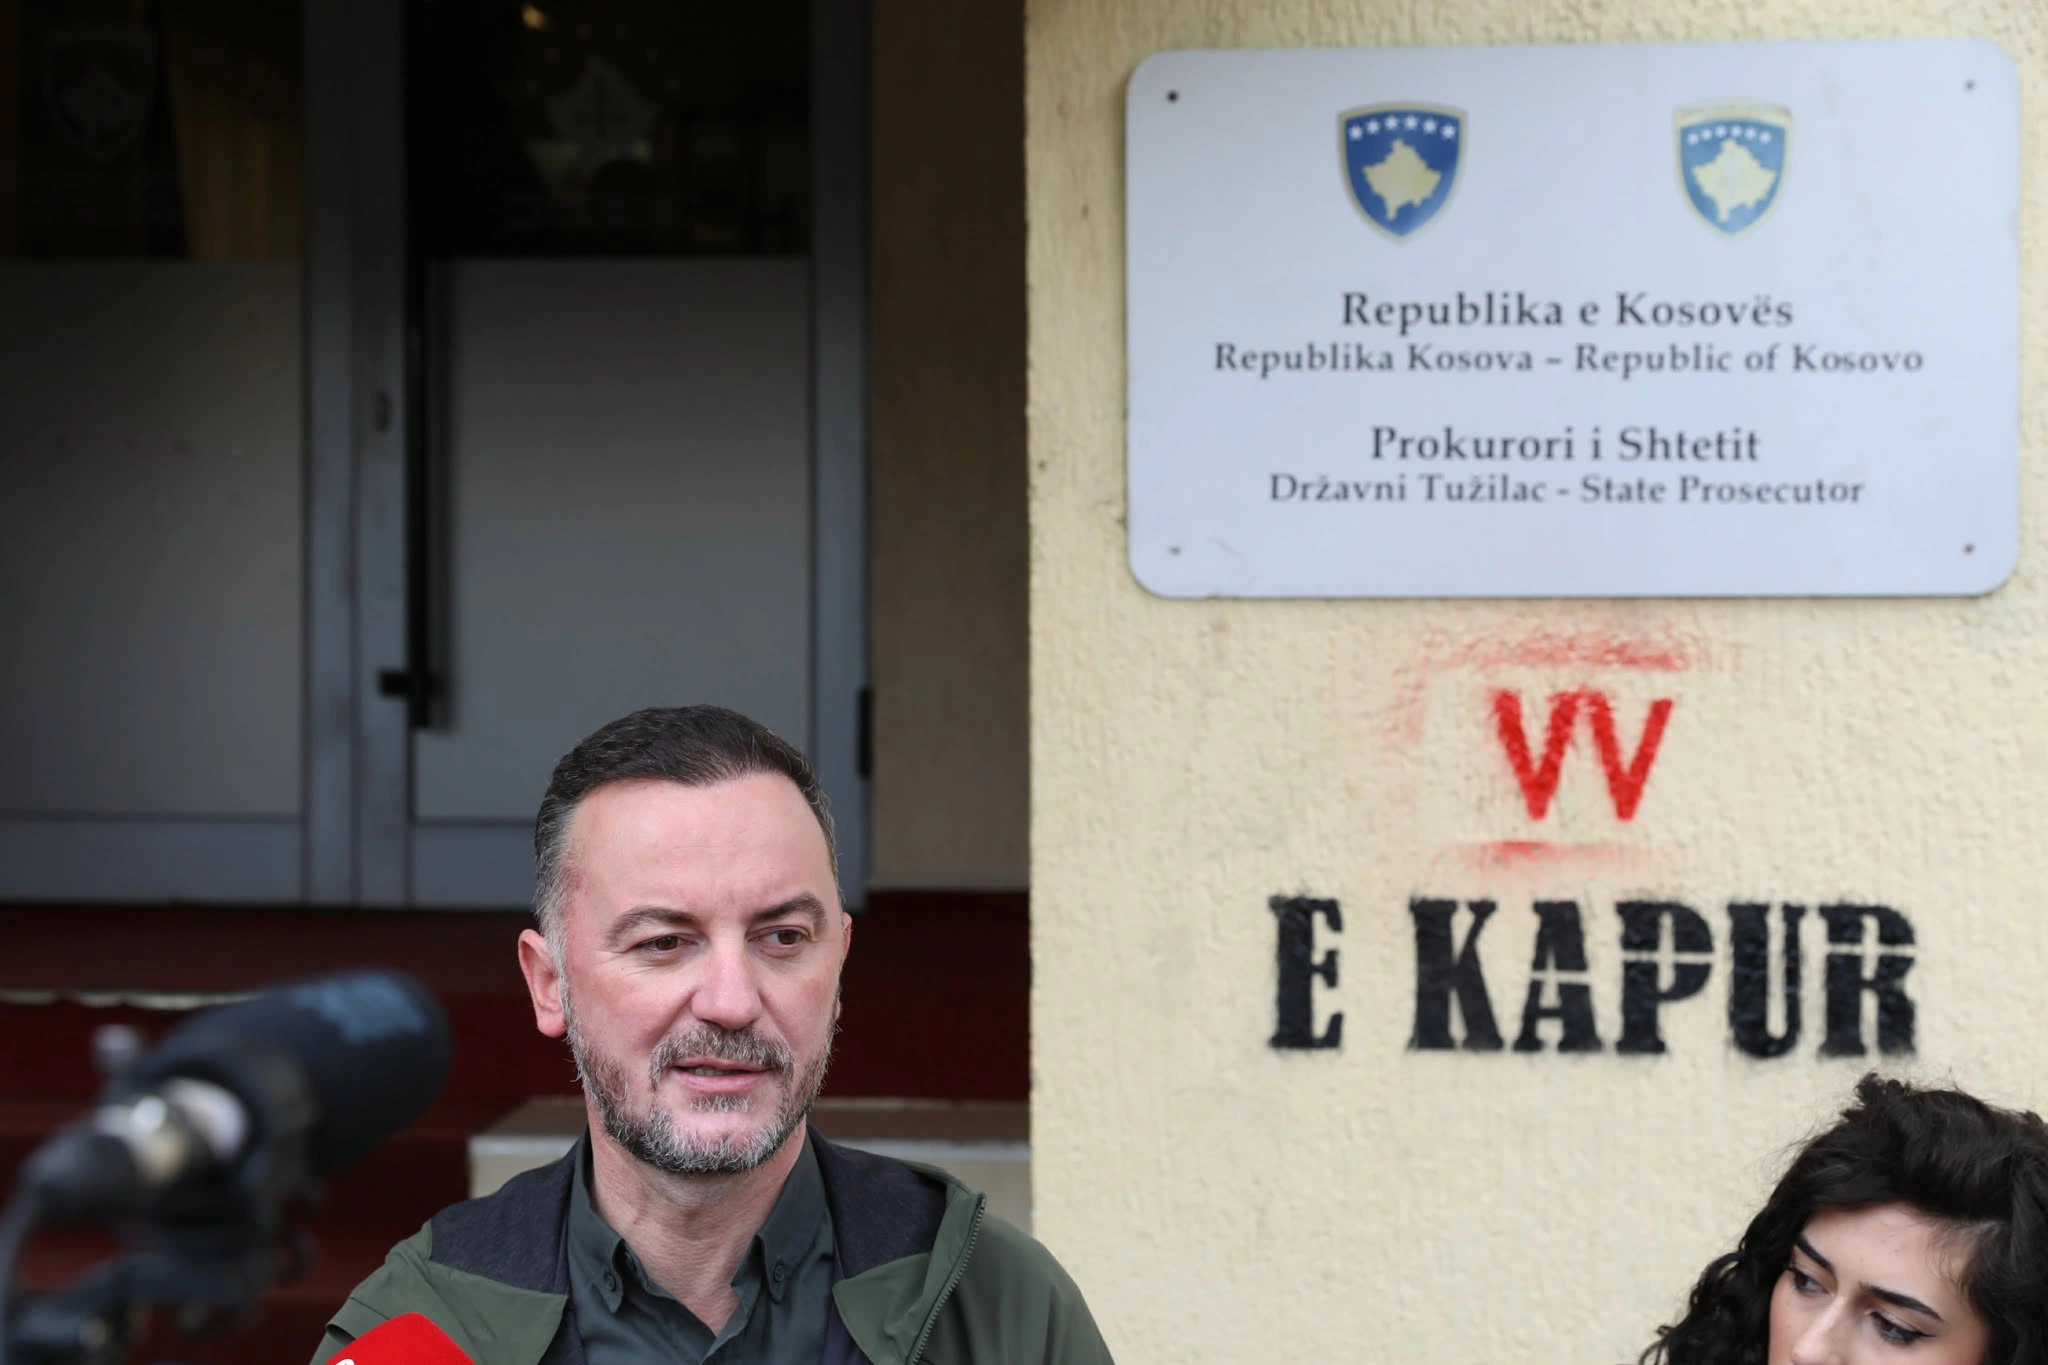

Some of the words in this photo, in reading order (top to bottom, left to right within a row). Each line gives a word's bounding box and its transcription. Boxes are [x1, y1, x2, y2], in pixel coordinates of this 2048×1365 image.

[1342, 292, 1564, 335] Republika
[1579, 304, 1600, 325] e
[1616, 292, 1795, 326] Kosovës
[1214, 342, 1394, 381] Republika
[1409, 343, 1534, 371] Kosova
[1575, 341, 1731, 380] Republic
[1744, 343, 1778, 370] of
[1793, 344, 1925, 371] Kosovo
[1371, 426, 1576, 461] Prokurori
[1591, 426, 1603, 461] i
[1618, 426, 1760, 462] Shtetit
[1269, 472, 1407, 502] Državni
[1418, 473, 1546, 502] Tužilac
[1581, 475, 1666, 503] State
[1678, 475, 1865, 504] Prosecutor
[1268, 894, 1344, 1051] E
[1407, 896, 1918, 1060] KAPUR
